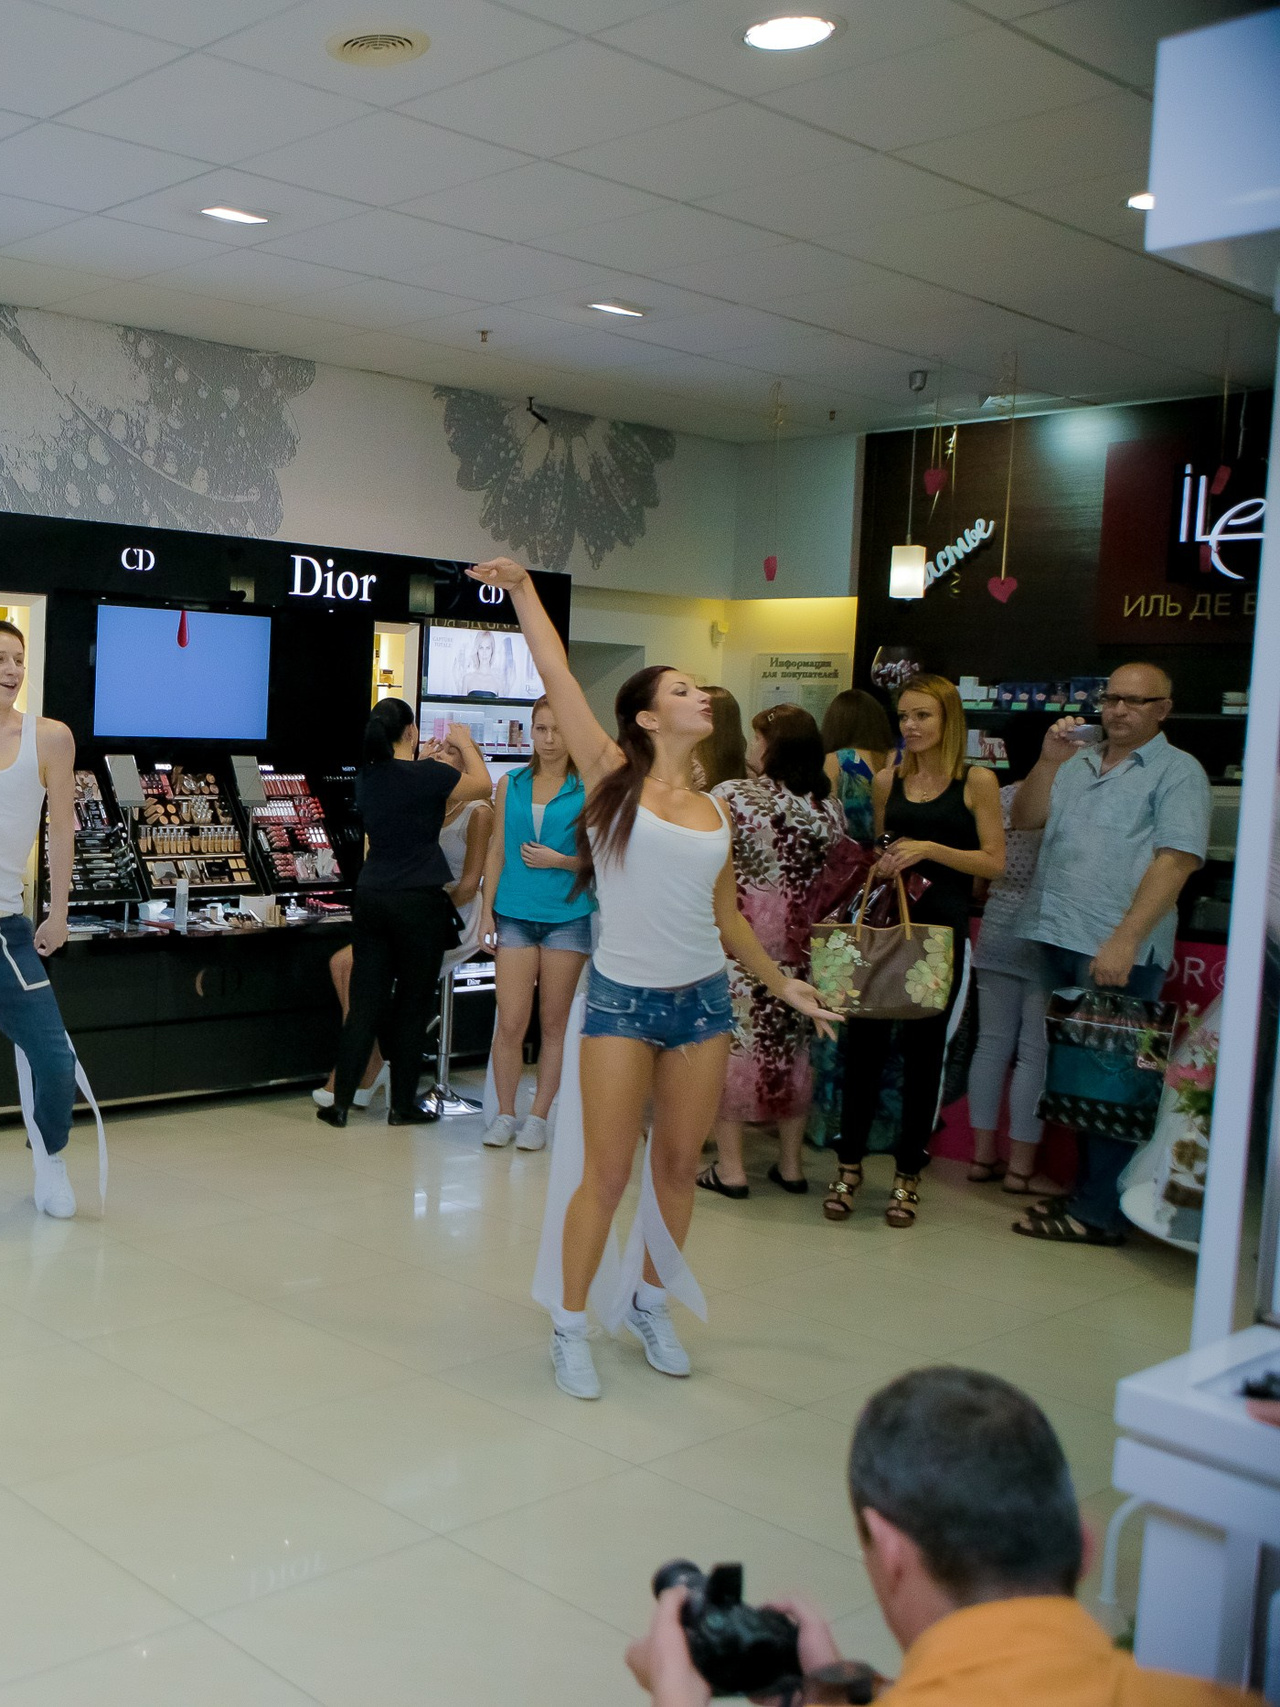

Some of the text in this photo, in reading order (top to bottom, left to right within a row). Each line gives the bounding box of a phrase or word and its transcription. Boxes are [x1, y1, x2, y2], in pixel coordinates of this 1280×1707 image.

[288, 554, 376, 602] Dior
[1123, 594, 1182, 618] ИЛЬ
[1189, 593, 1231, 621] ДЕ
[769, 657, 832, 669] Информация
[761, 669, 839, 680] для покупателей
